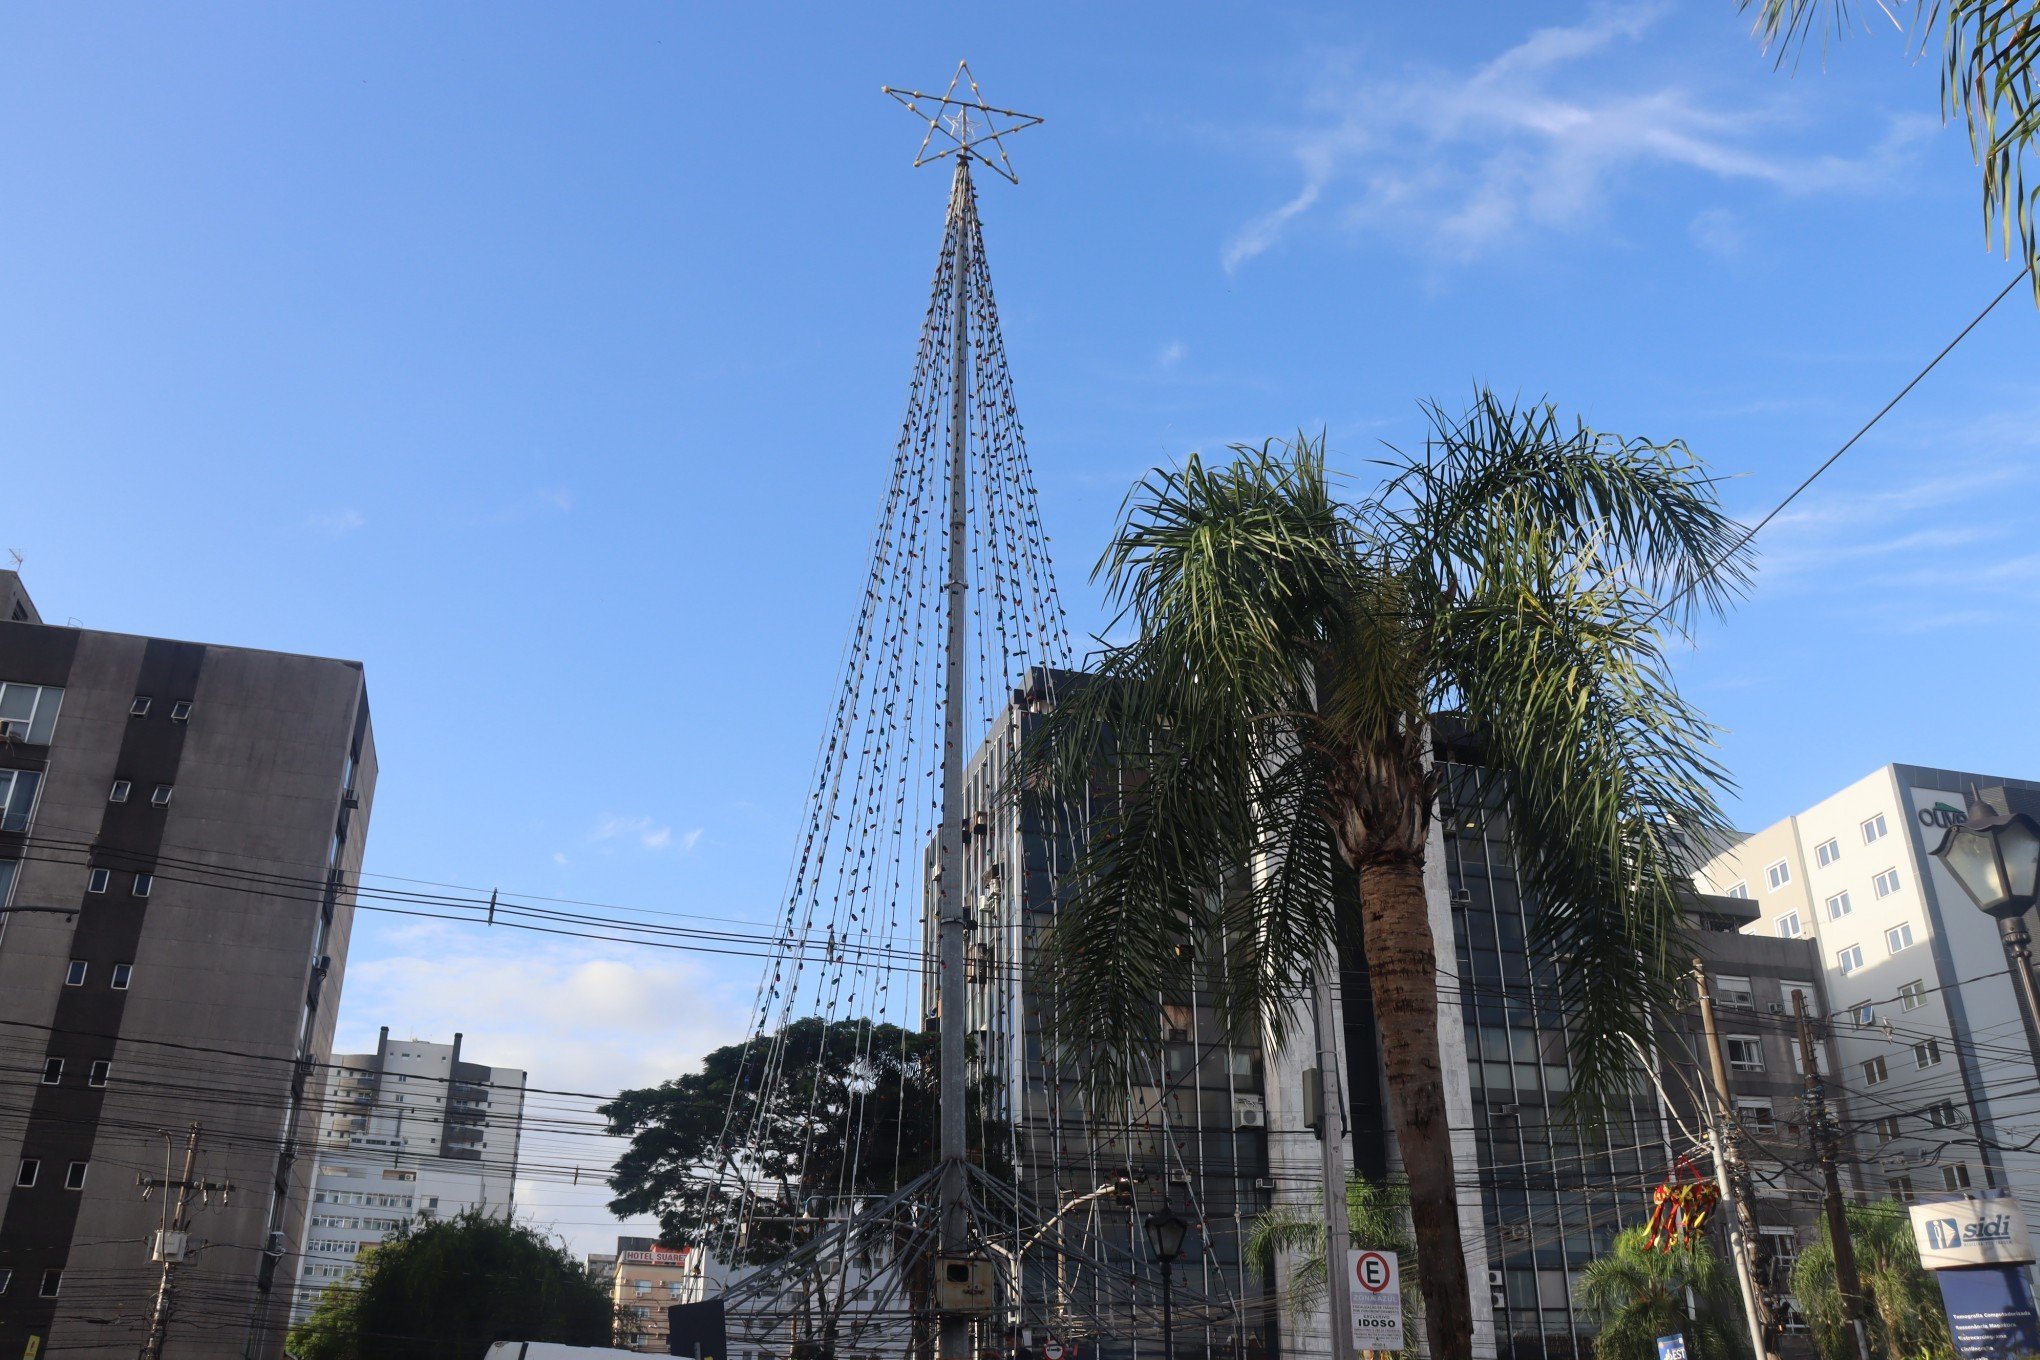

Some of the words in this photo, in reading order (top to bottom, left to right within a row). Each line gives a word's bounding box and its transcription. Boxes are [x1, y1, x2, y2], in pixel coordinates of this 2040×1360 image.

[1963, 1214, 2010, 1238] sidi
[627, 1251, 653, 1260] HOTEL
[1366, 1261, 1380, 1283] E
[1377, 1295, 1398, 1303] AZUL
[1358, 1319, 1396, 1328] IDOSO
